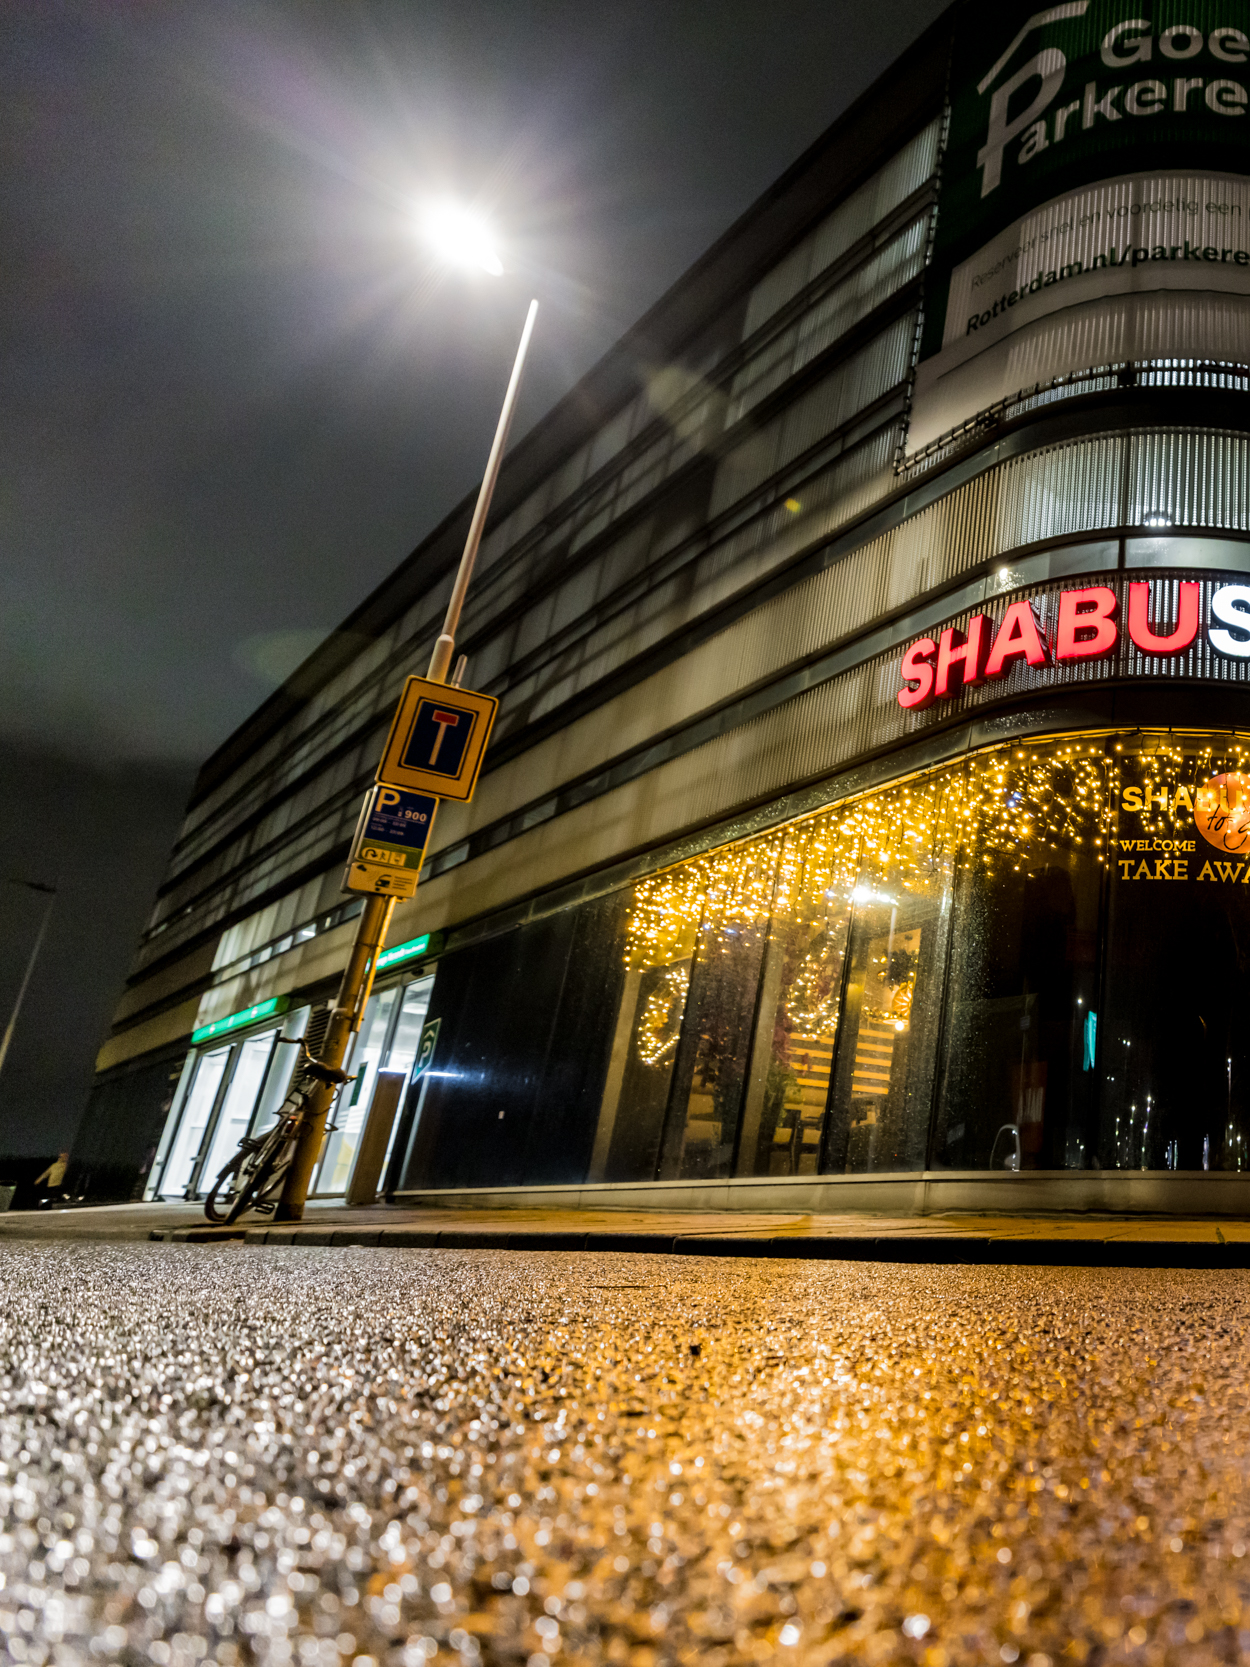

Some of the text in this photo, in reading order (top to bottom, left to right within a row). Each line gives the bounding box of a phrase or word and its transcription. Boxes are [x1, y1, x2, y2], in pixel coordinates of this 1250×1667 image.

[971, 236, 1037, 291] Reserveer
[1039, 216, 1074, 243] snel
[1079, 210, 1101, 228] en
[1106, 197, 1199, 219] voordelig
[1205, 201, 1242, 216] een
[375, 787, 401, 812] P
[1121, 786, 1243, 813] SHABU
[404, 809, 428, 822] 900
[1119, 839, 1196, 853] WELCOME
[1118, 859, 1189, 881] TAKE
